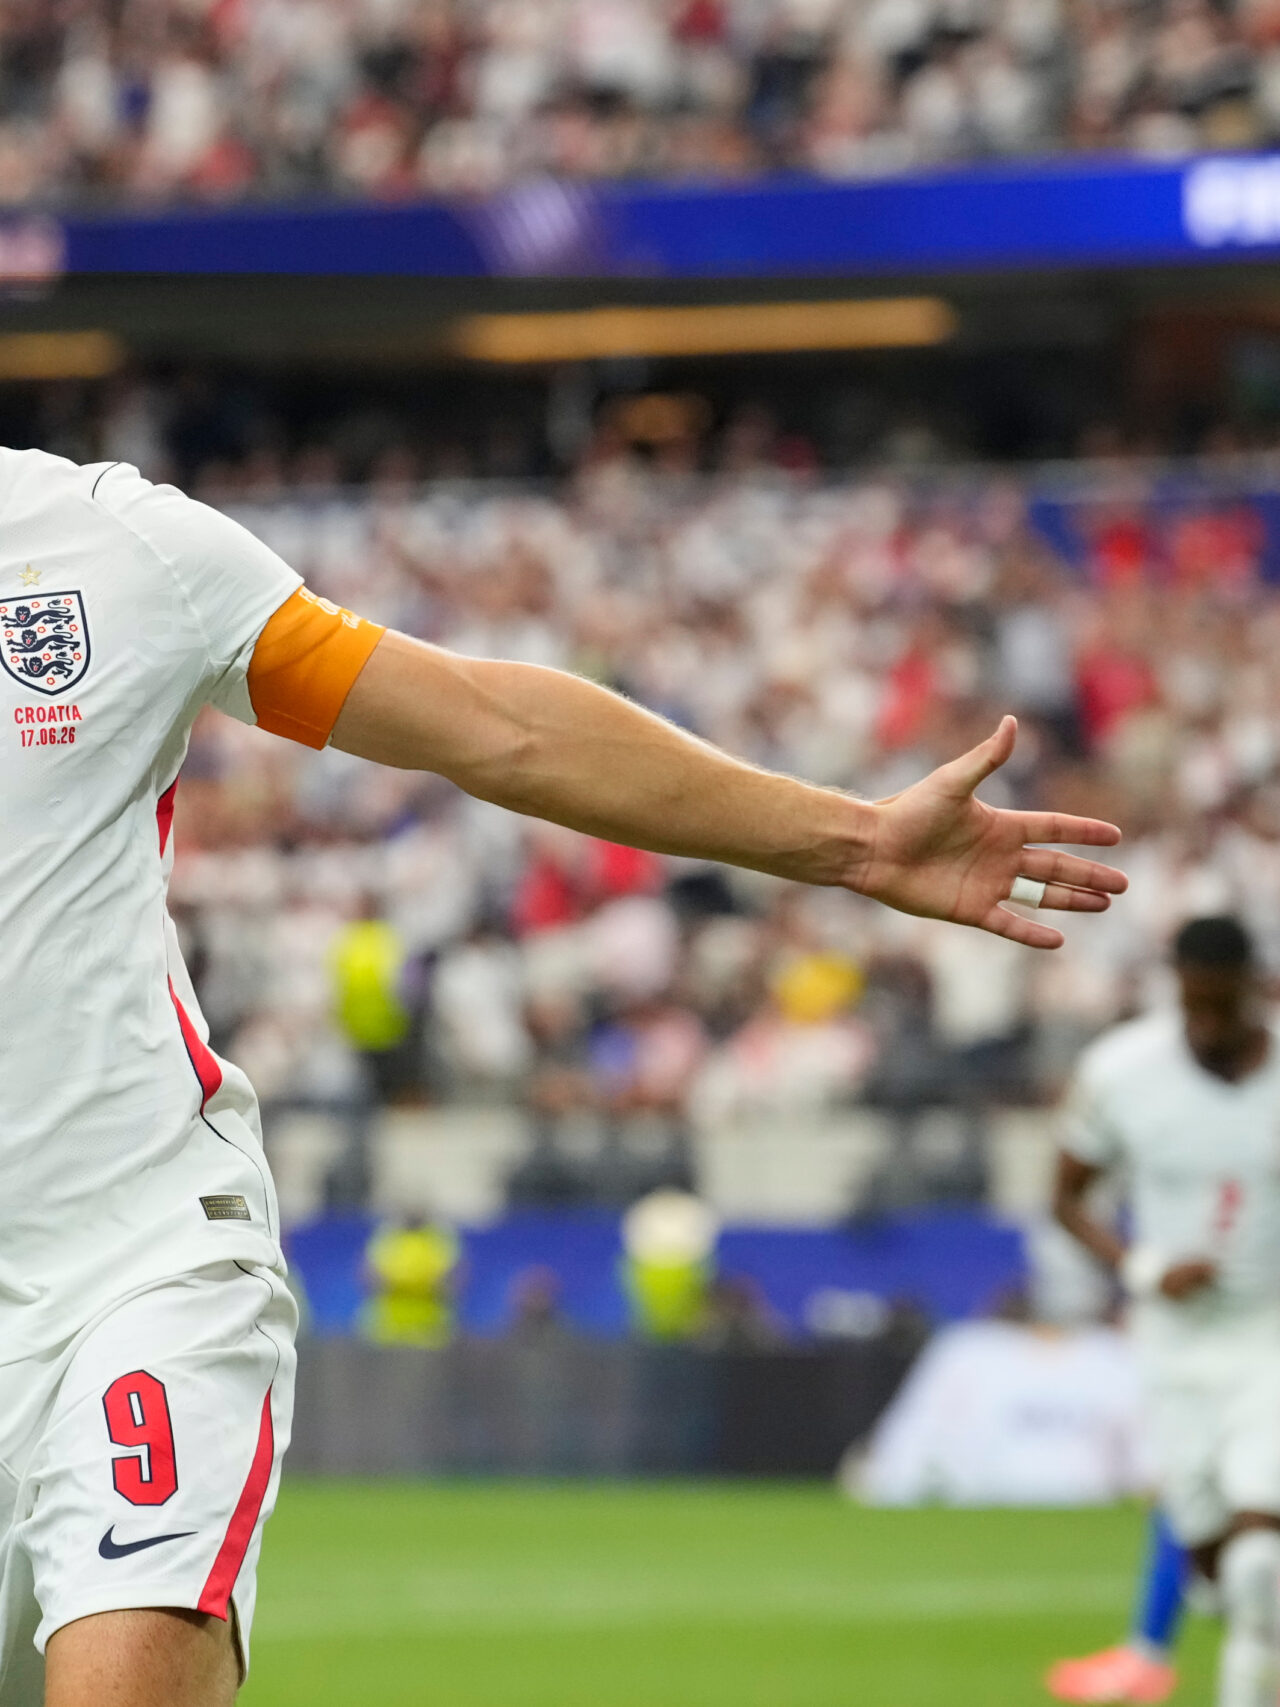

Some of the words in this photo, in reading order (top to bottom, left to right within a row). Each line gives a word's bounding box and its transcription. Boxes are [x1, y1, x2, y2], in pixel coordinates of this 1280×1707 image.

[14, 705, 82, 724] CROATIA
[20, 726, 76, 747] 17.06.26
[101, 1369, 179, 1506] 9
